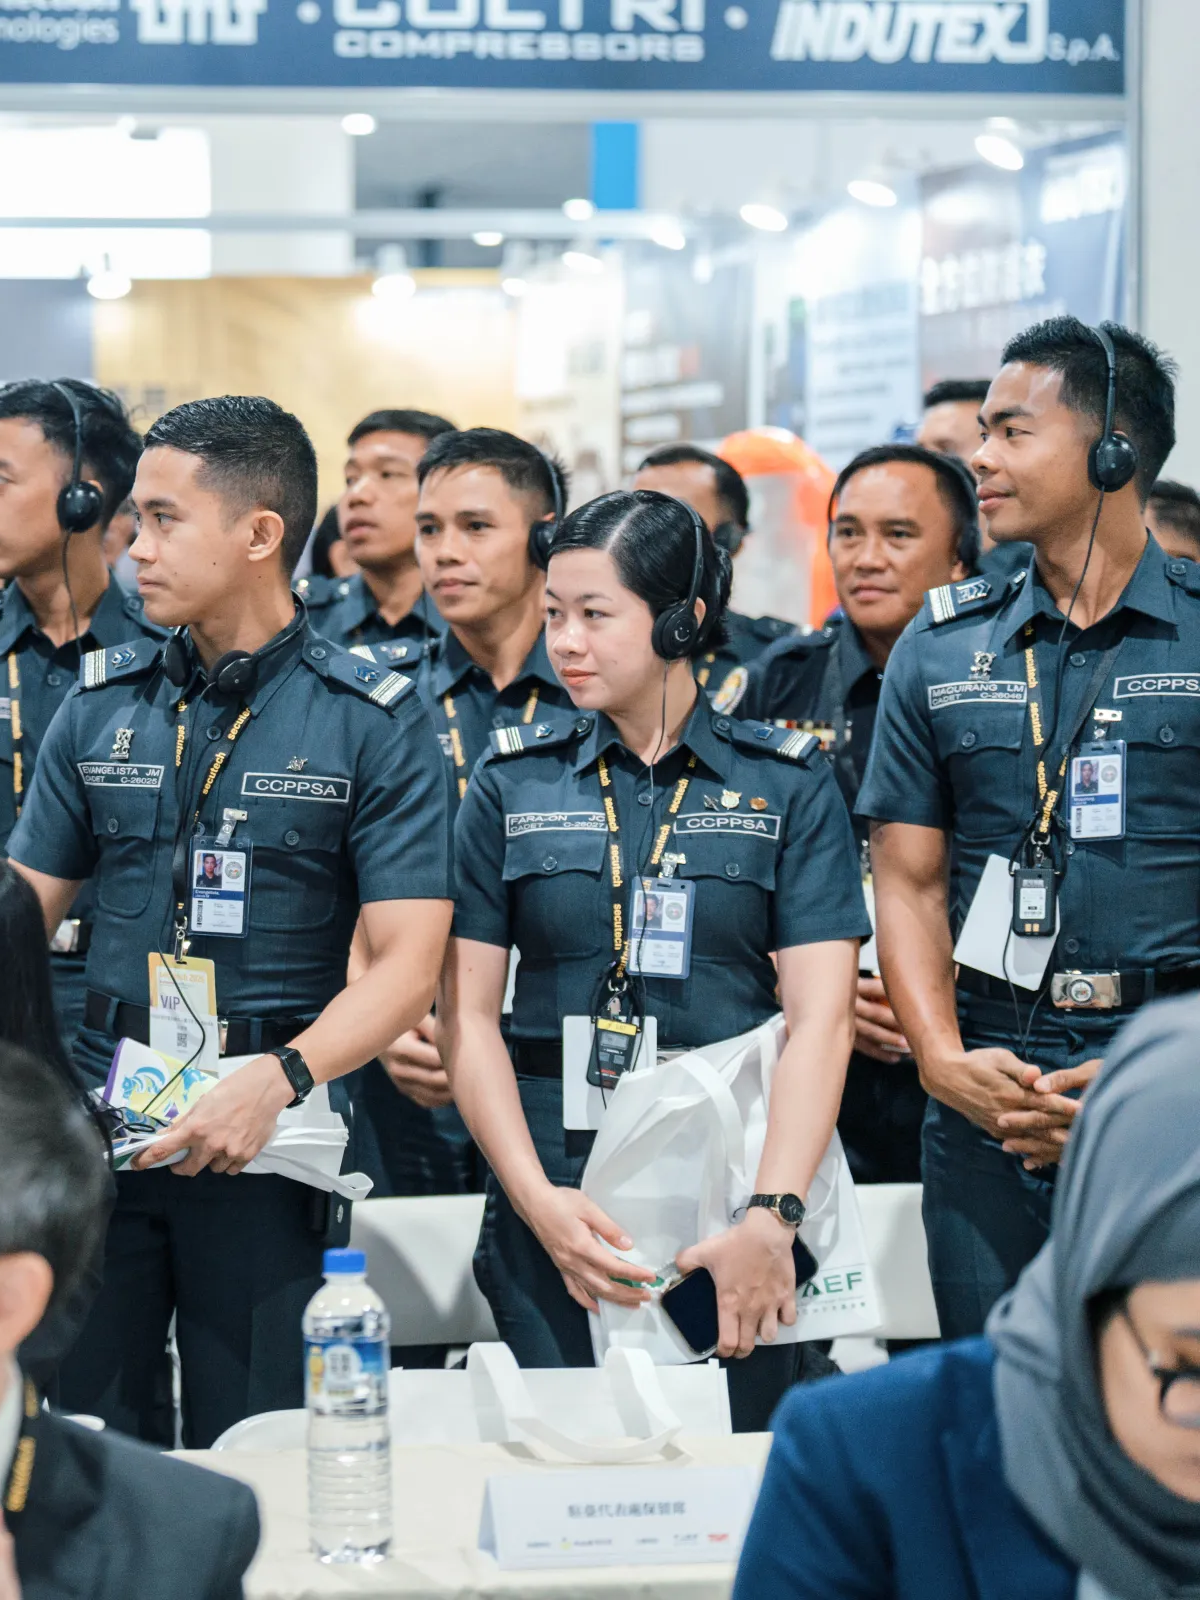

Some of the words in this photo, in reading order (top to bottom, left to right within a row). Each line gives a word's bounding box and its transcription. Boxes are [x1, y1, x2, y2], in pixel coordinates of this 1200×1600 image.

[333, 29, 705, 62] COMPRESSORS
[1025, 648, 1038, 689] secutech
[1127, 679, 1200, 692] CCPPS
[932, 684, 997, 697] MAQUIRANG
[1006, 684, 1024, 692] LM
[932, 694, 961, 706] CADET
[1029, 702, 1044, 746] secutech
[175, 725, 185, 767] secutech
[82, 766, 138, 775] EVANGELISTA
[203, 752, 226, 795] secutech
[255, 779, 338, 797] CCPPSA
[669, 778, 689, 814] secutech
[510, 823, 544, 833] CADET
[603, 796, 620, 833] secutech
[686, 817, 768, 832] CCPPSA
[652, 824, 672, 865] secutech
[611, 844, 624, 888] secutech
[613, 903, 623, 950] secutech
[160, 995, 180, 1010] VIP
